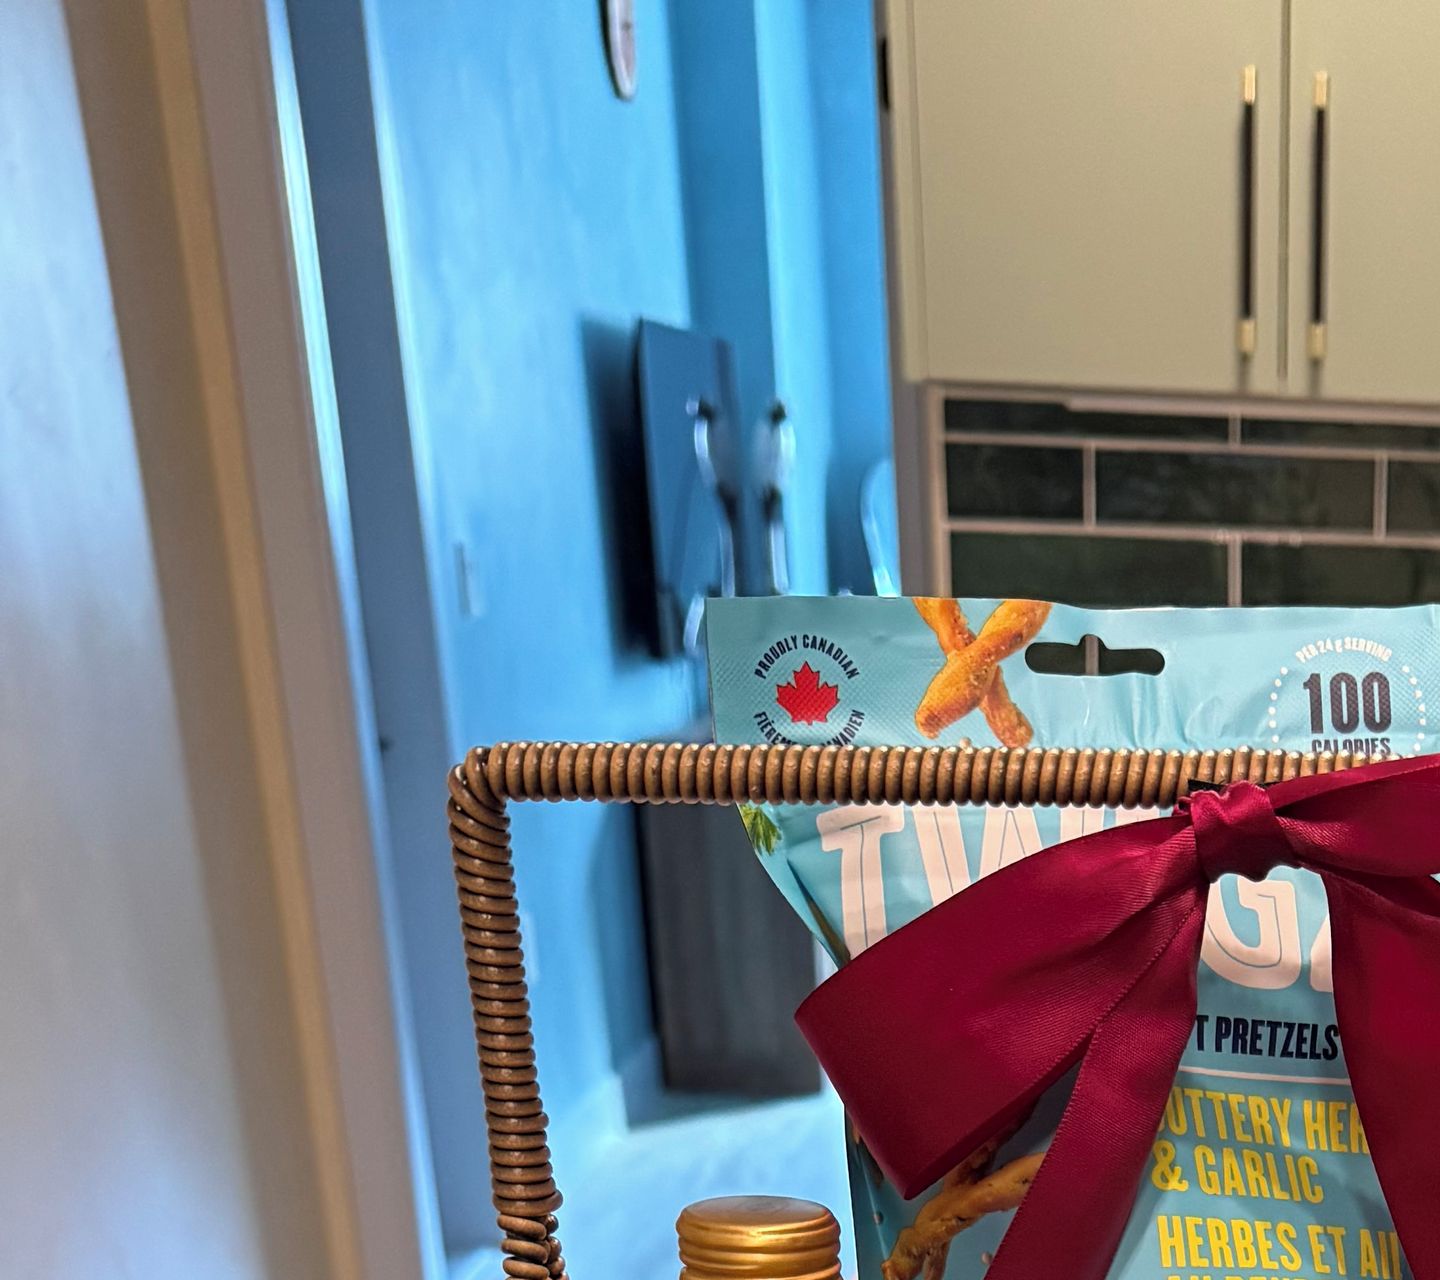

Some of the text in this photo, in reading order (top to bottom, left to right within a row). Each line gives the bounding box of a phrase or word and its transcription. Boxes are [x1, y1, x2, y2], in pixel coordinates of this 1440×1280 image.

[754, 633, 860, 680] PROUDLY CANADIAN
[1295, 643, 1319, 663] PER
[1317, 638, 1333, 653] 24
[1344, 636, 1392, 662] SERVING
[1303, 671, 1392, 734] 100
[1214, 1015, 1340, 1061] PRETZELS
[1159, 1086, 1292, 1148] UTTERY
[1151, 1139, 1325, 1204] & GARLIC
[1156, 1215, 1302, 1272] HERBES
[1306, 1224, 1347, 1277] ET
